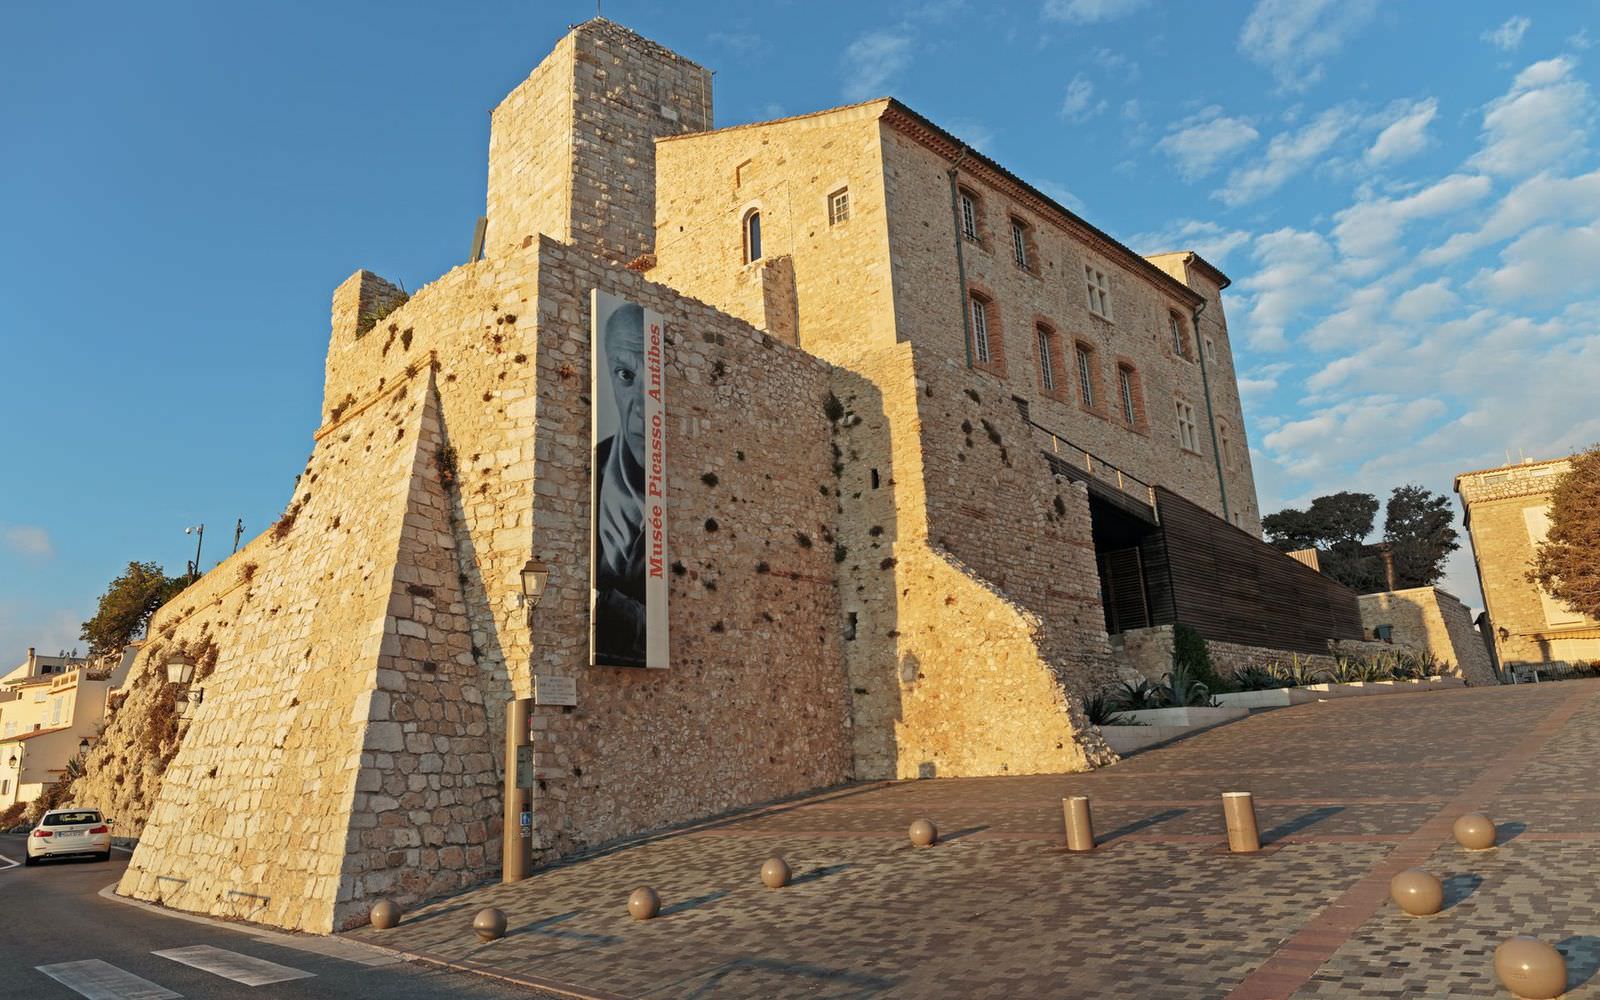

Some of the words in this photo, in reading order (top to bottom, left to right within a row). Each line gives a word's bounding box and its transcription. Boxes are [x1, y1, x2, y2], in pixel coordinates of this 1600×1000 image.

[648, 324, 662, 403] Antibes
[649, 410, 663, 498] Picasso,
[649, 506, 663, 578] Musée
